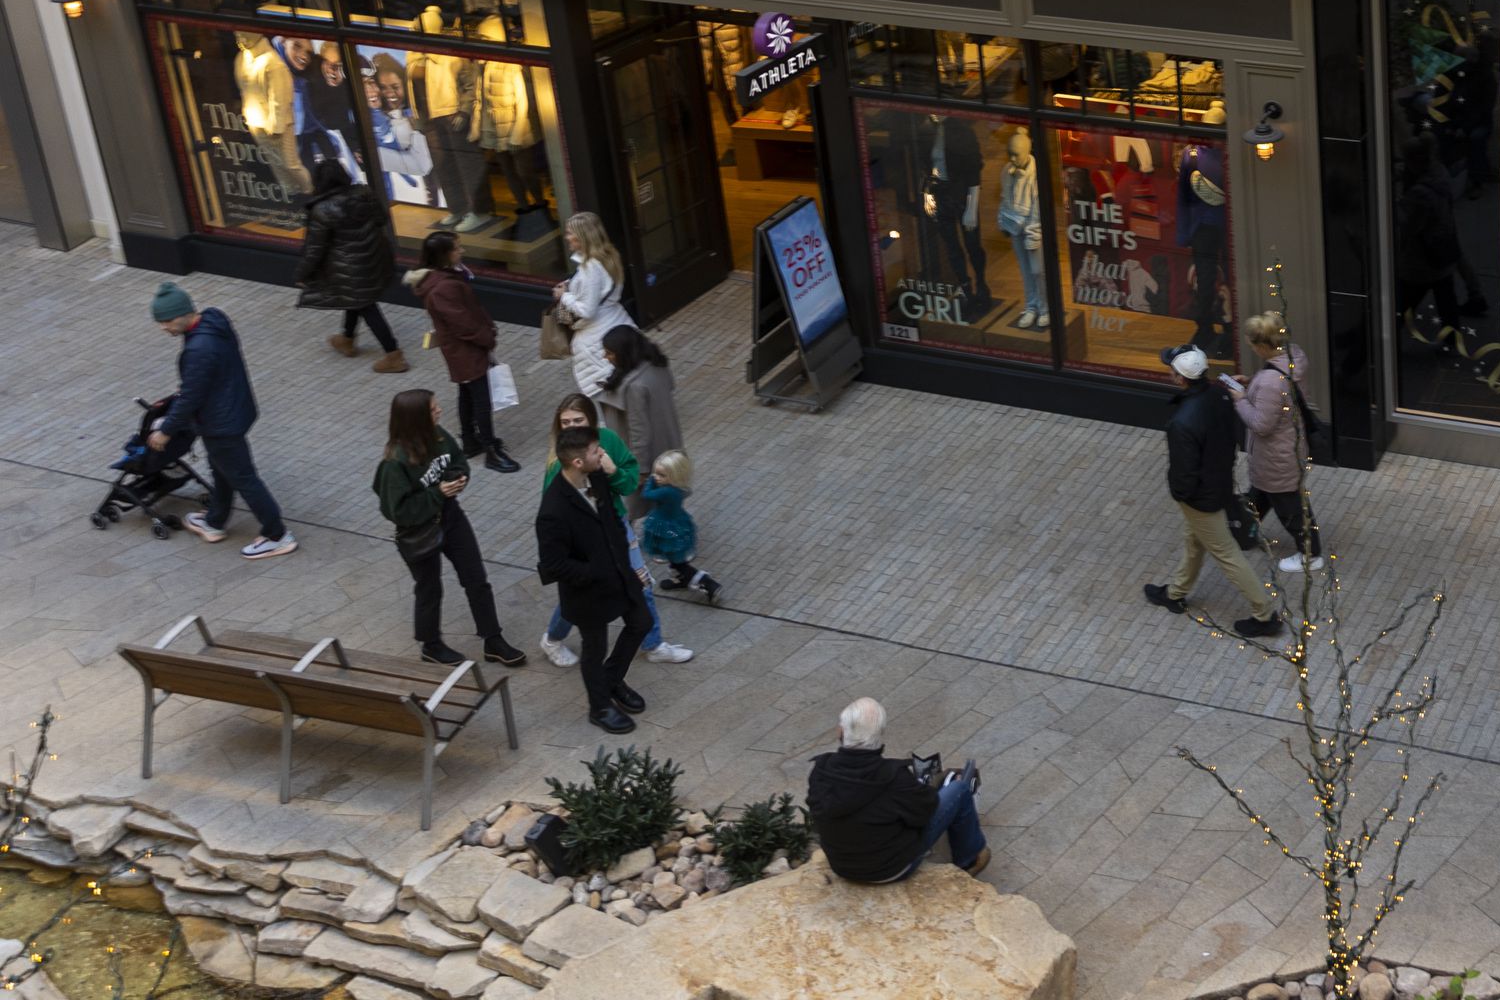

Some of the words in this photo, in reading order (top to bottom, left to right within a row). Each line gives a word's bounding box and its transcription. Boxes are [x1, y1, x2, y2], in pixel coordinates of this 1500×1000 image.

[749, 48, 817, 97] ATHLETA
[220, 170, 294, 204] Effect
[1074, 200, 1124, 224] THE
[783, 230, 822, 268] 25%
[1067, 224, 1138, 250] GIFTS
[791, 251, 826, 288] OFF
[896, 278, 967, 300] ATHLETA
[888, 326, 910, 338] 121
[1090, 308, 1129, 332] her
